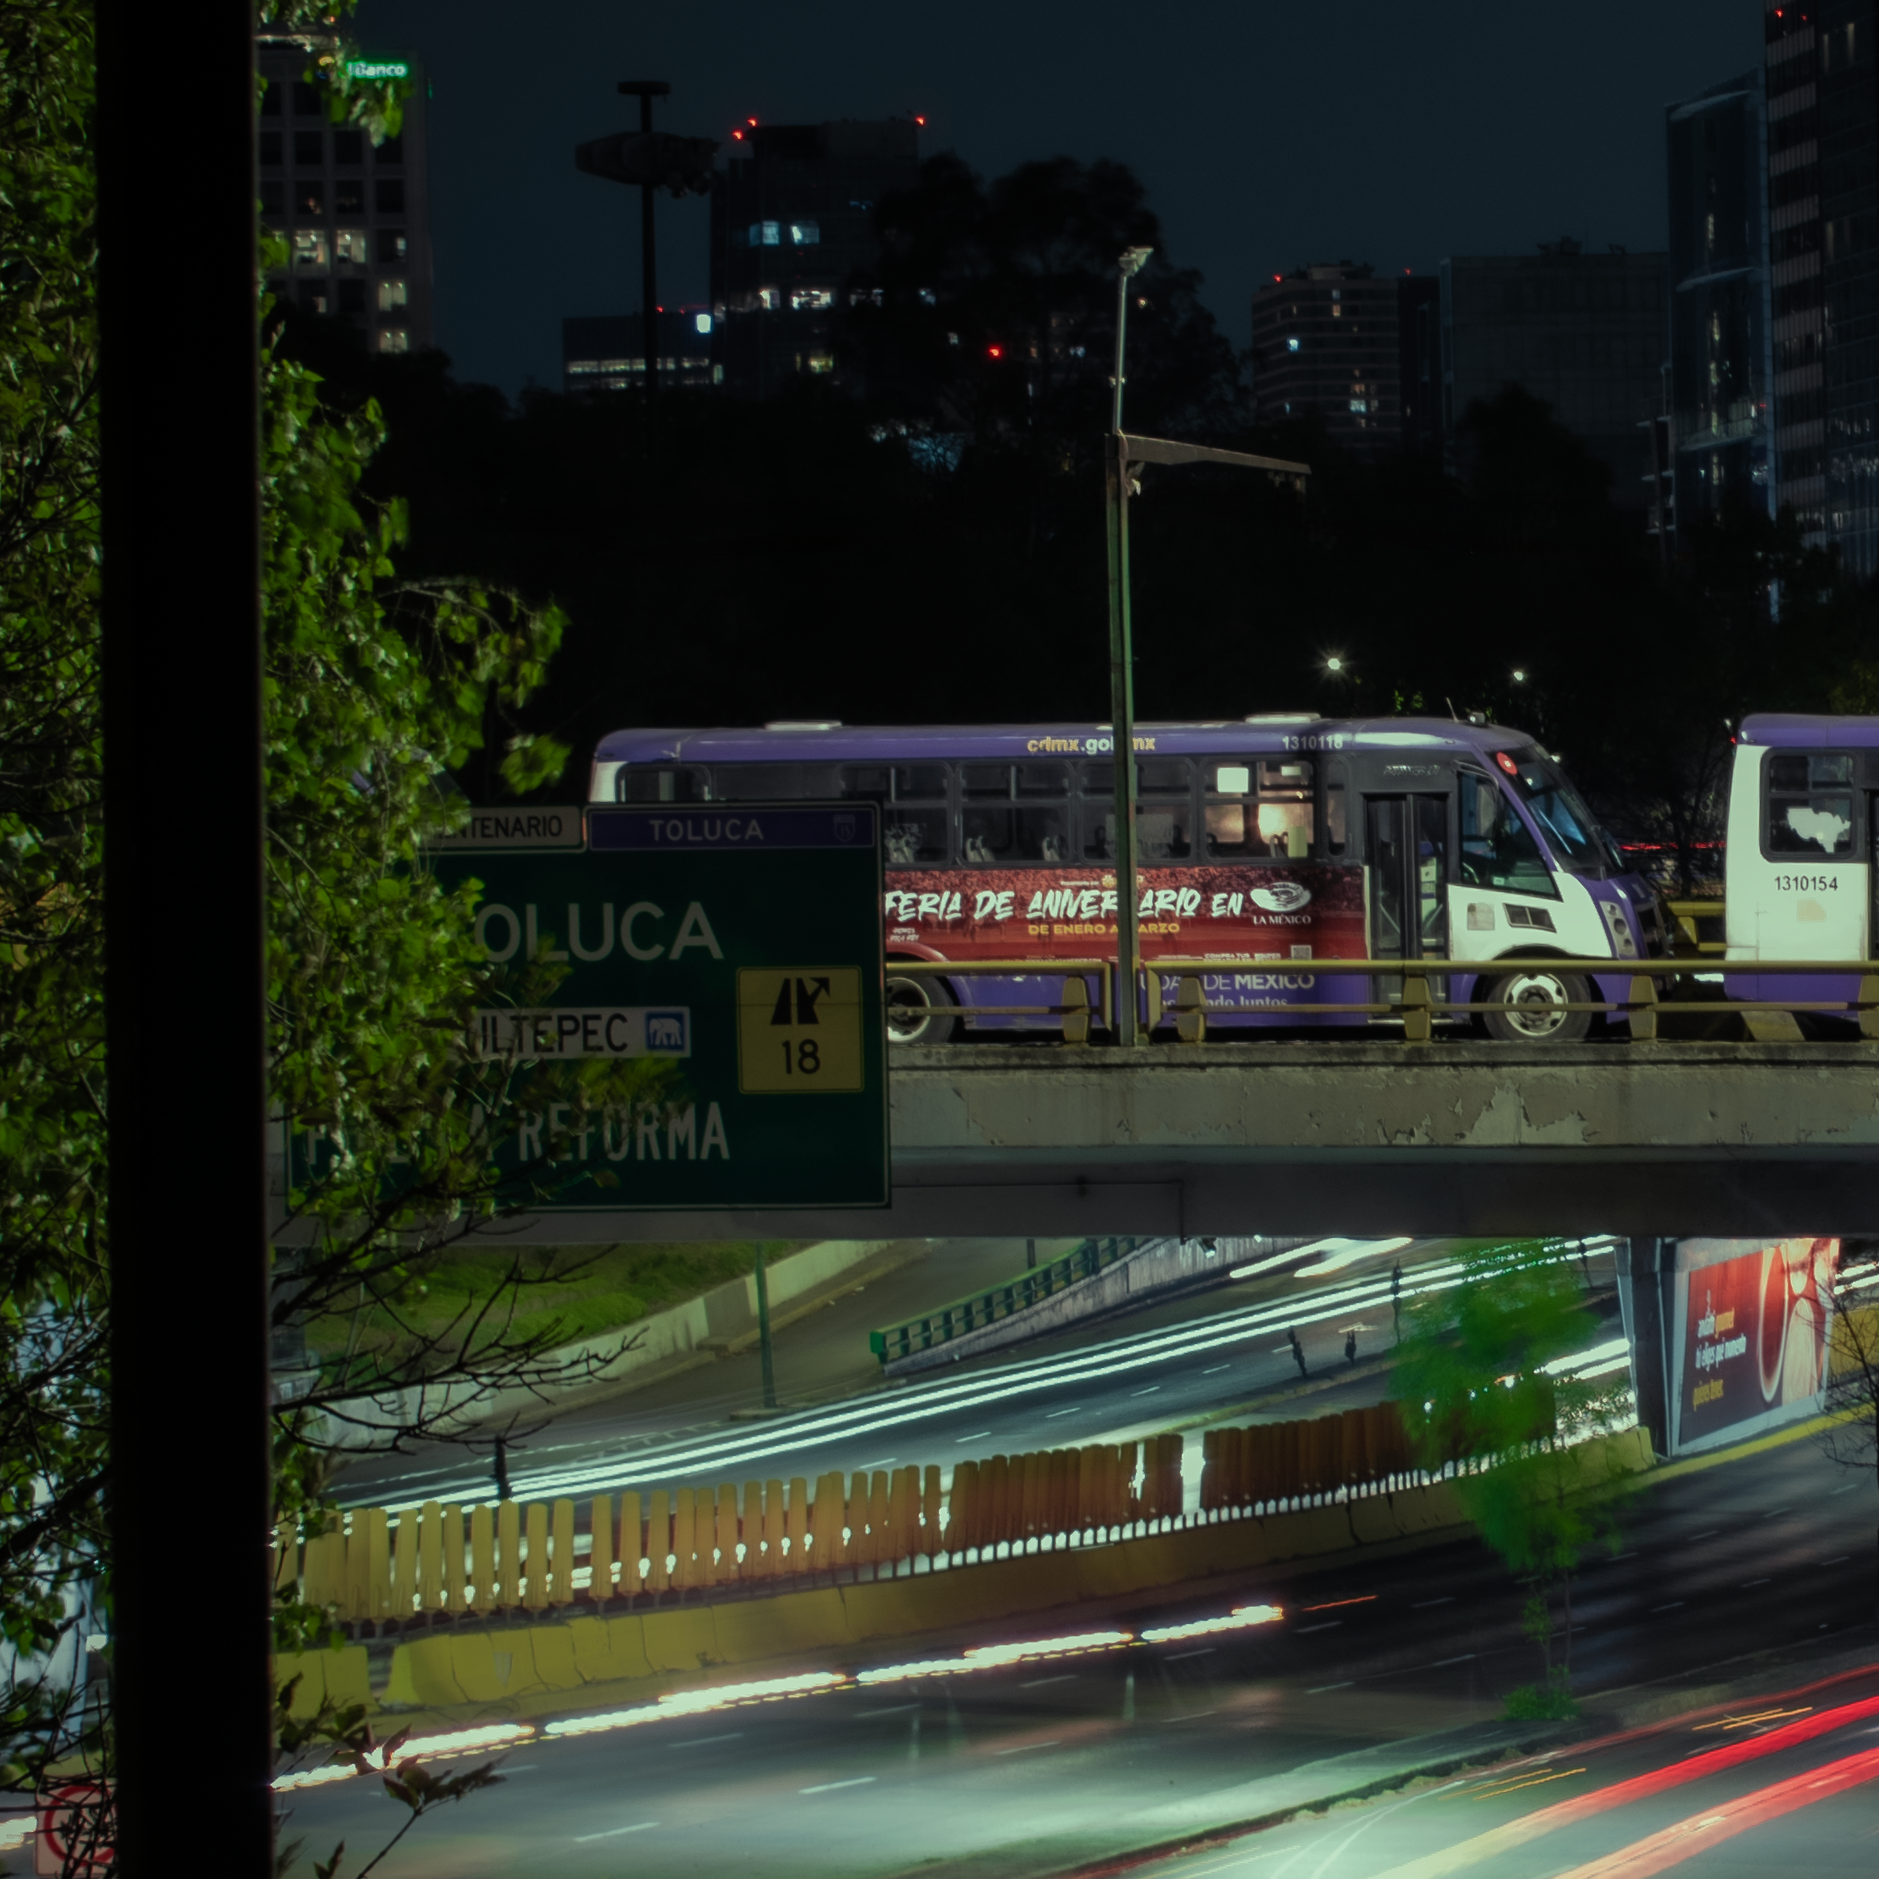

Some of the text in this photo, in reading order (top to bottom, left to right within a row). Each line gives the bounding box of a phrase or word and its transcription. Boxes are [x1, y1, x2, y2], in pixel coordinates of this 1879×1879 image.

[1282, 734, 1344, 750] 1310118
[649, 819, 764, 842] TOLUCA
[1773, 875, 1839, 891] 1310154
[885, 887, 1243, 922] FERIA DE ANIVERARIO EN
[1028, 923, 1050, 935] DE
[1053, 923, 1107, 935] ENERO
[1137, 922, 1181, 934] ARZO
[1253, 913, 1312, 925] LA MÉXICO
[474, 901, 725, 963] OLUCA
[782, 1038, 821, 1075] 18
[518, 1100, 731, 1162] REFORMA
